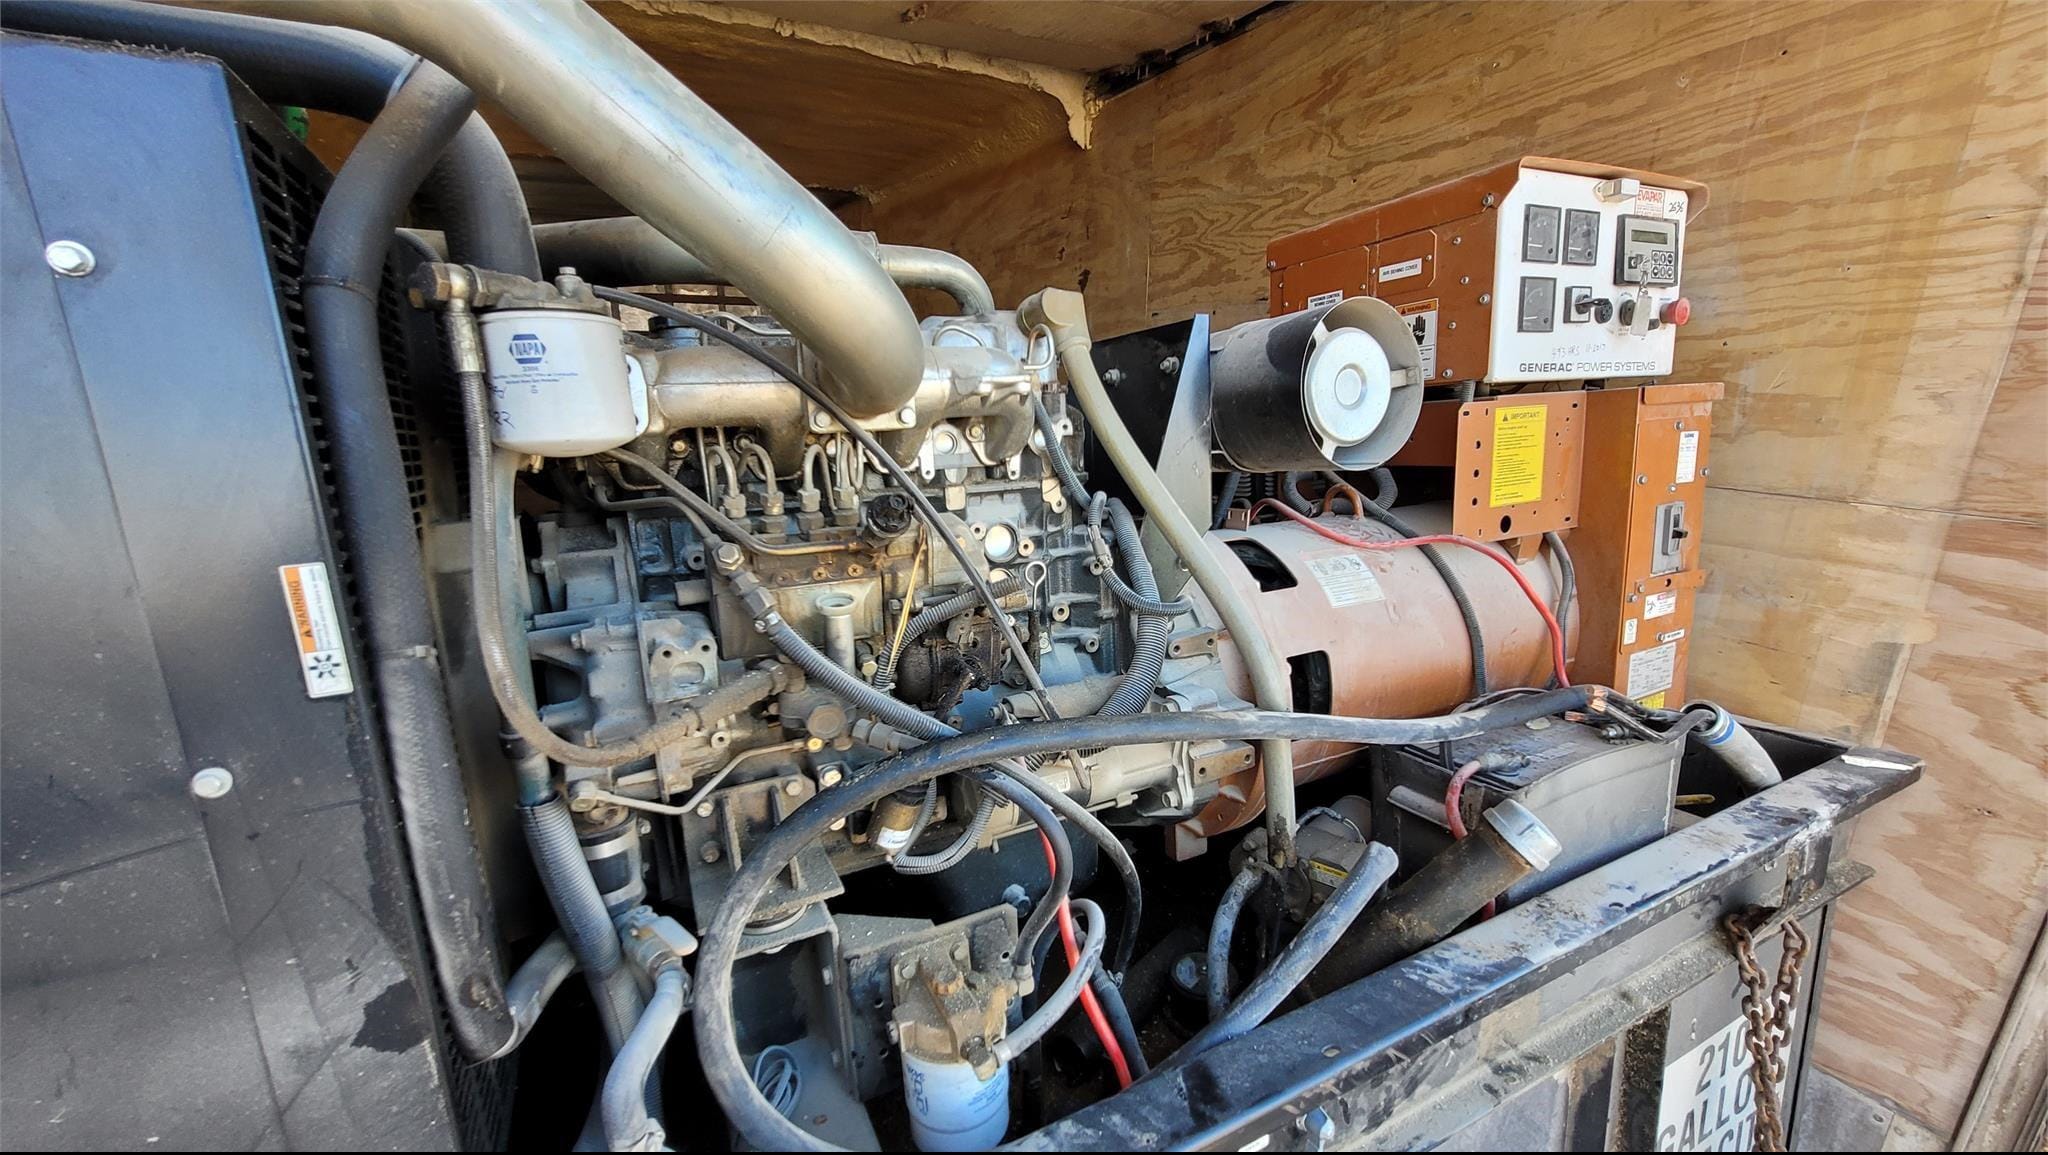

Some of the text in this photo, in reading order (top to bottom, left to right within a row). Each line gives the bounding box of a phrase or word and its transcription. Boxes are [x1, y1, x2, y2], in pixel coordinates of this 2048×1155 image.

[1637, 190, 1663, 203] EVAPAR
[1407, 303, 1432, 313] WARNING
[515, 342, 541, 356] NAPA
[1519, 361, 1656, 373] GENERAC POWER SYSTEMS
[1510, 411, 1540, 420] IMPORTANT
[287, 580, 312, 629] WARNING
[1695, 1020, 1751, 1097] 210
[1658, 1066, 1754, 1152] GALLO
